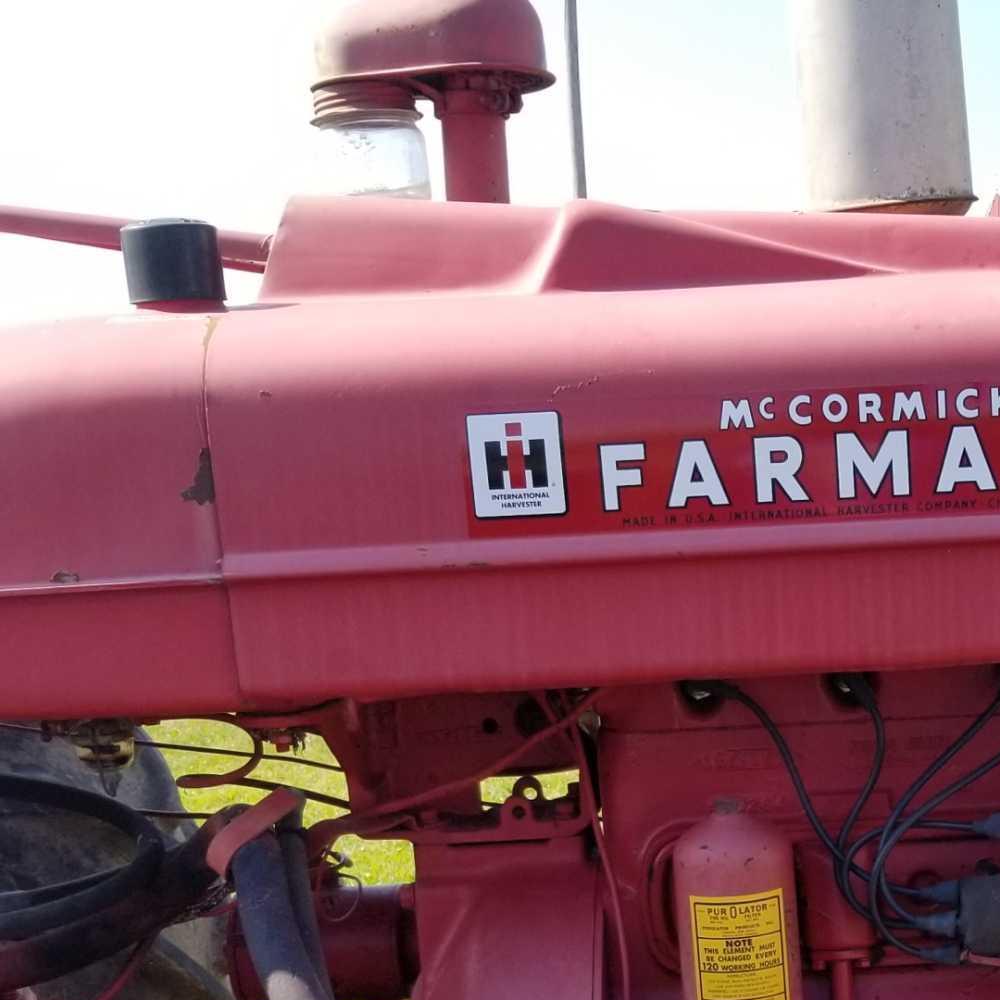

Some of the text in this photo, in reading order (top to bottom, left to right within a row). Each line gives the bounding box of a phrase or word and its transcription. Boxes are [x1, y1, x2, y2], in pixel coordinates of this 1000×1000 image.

[491, 491, 550, 501] INTERNATIONAL
[623, 514, 656, 526] MADE
[665, 515, 678, 525] IN
[729, 506, 827, 520] INTERNATIONAL
[837, 502, 908, 516] HARVESTER
[918, 499, 977, 511] COMPANY
[704, 942, 775, 955] THIS ELEMENT MUST
[725, 938, 753, 948] NOTE
[718, 954, 751, 962] CHANGED
[755, 950, 776, 960] EVERY
[702, 958, 780, 971] 120 WORKING HOURS
